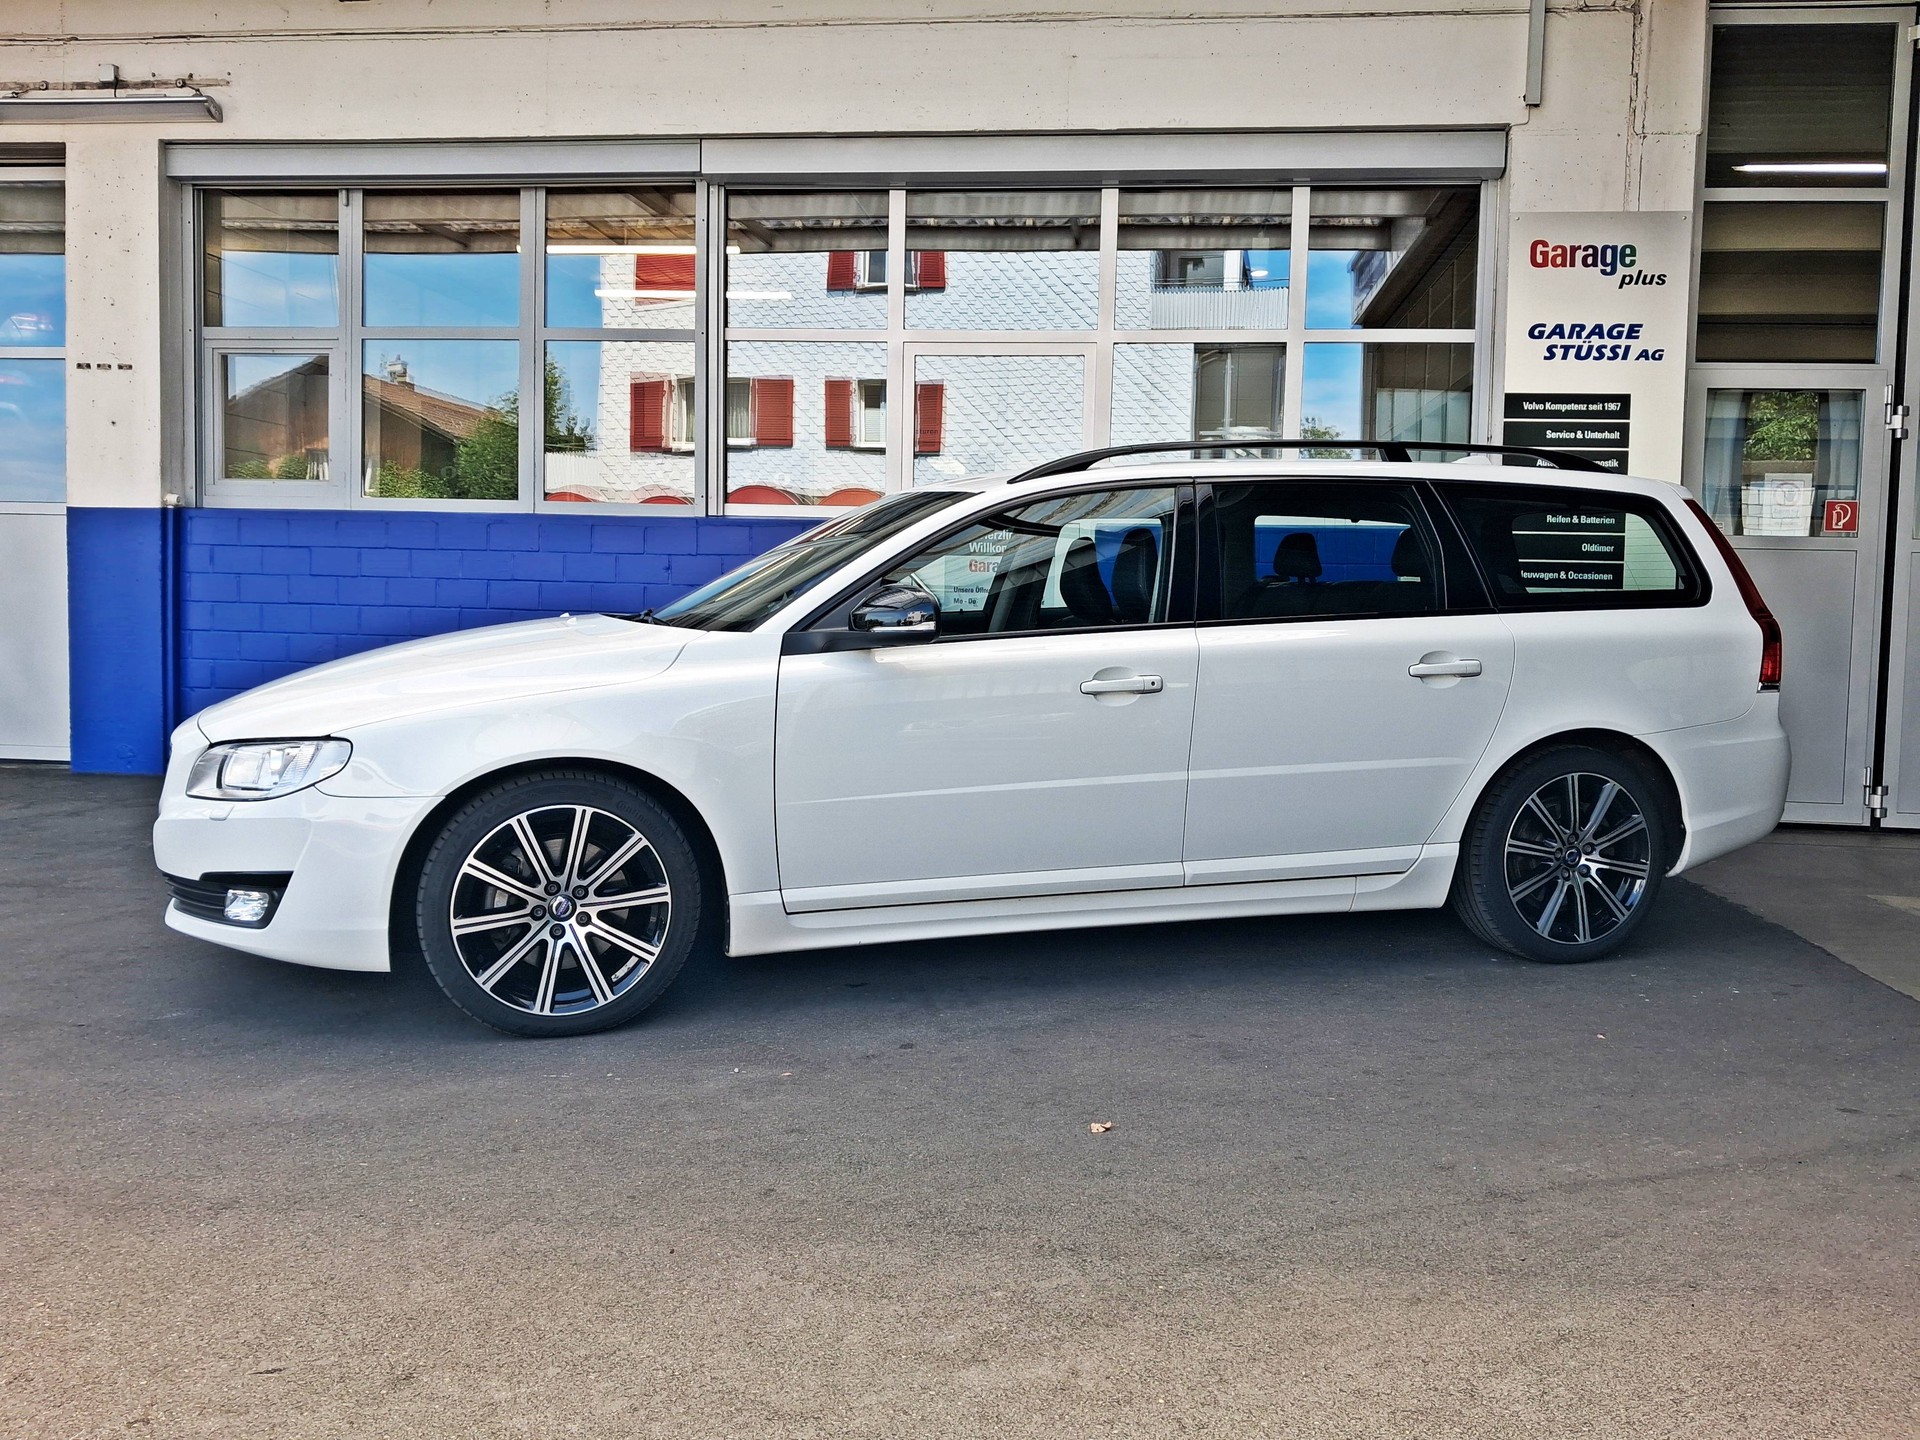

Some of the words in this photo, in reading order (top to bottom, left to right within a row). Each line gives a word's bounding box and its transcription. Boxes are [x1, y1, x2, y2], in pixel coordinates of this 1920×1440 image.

[1530, 239, 1637, 276] Garage
[1618, 270, 1667, 289] plus
[1528, 323, 1643, 340] GARAGE
[1543, 340, 1631, 361] STÜSSI
[1634, 349, 1665, 361] AG
[1523, 402, 1544, 411] Volvo
[1546, 402, 1587, 412] Kompetenz
[1588, 402, 1603, 411] seit
[1604, 402, 1621, 411] 1967
[1546, 430, 1575, 439] Service
[1576, 430, 1583, 439] &
[1584, 430, 1620, 440] Unterhalt
[1546, 515, 1571, 524] Reifen
[1572, 515, 1579, 524] &
[1580, 515, 1616, 525] Batterien
[1581, 543, 1614, 552] Oldtimer
[1560, 571, 1567, 580] &
[1568, 571, 1613, 581] Occasionen
